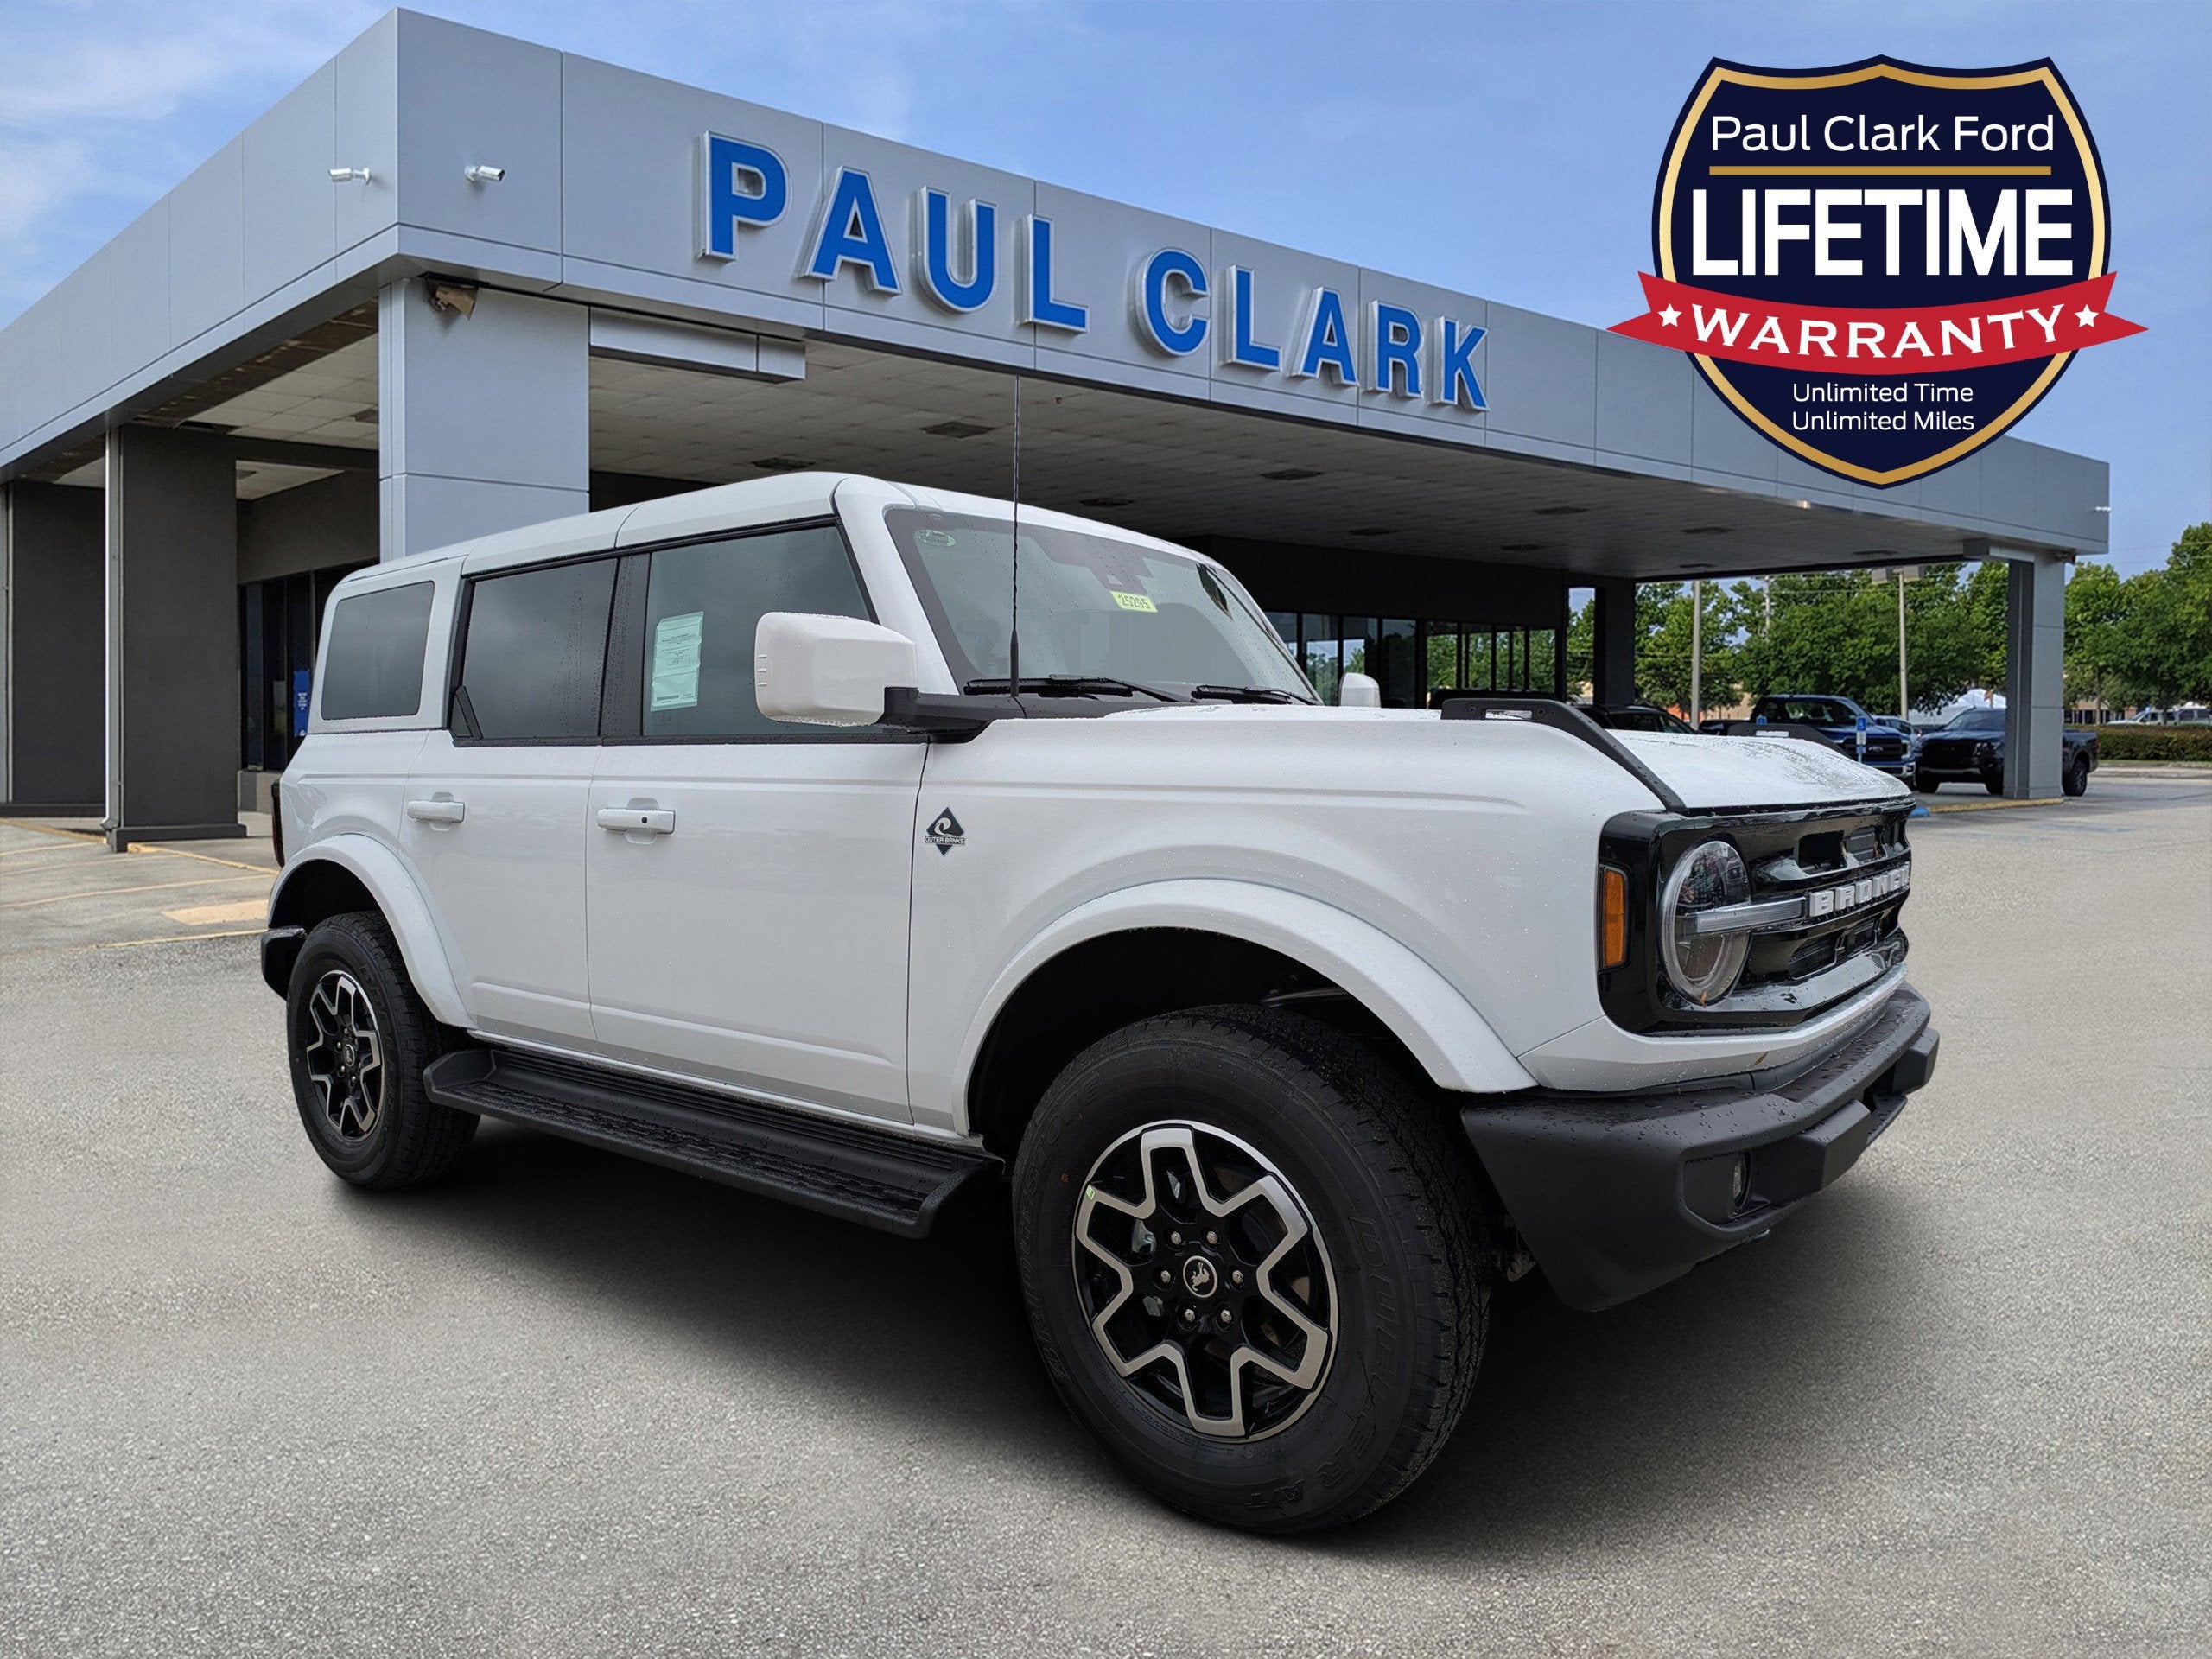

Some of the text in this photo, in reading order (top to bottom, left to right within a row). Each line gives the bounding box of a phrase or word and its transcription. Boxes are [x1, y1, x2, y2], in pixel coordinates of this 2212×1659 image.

[702, 131, 1491, 412] PAUL CLARK
[1118, 594, 1151, 609] 25295
[1315, 1214, 1398, 1489] DUELER
